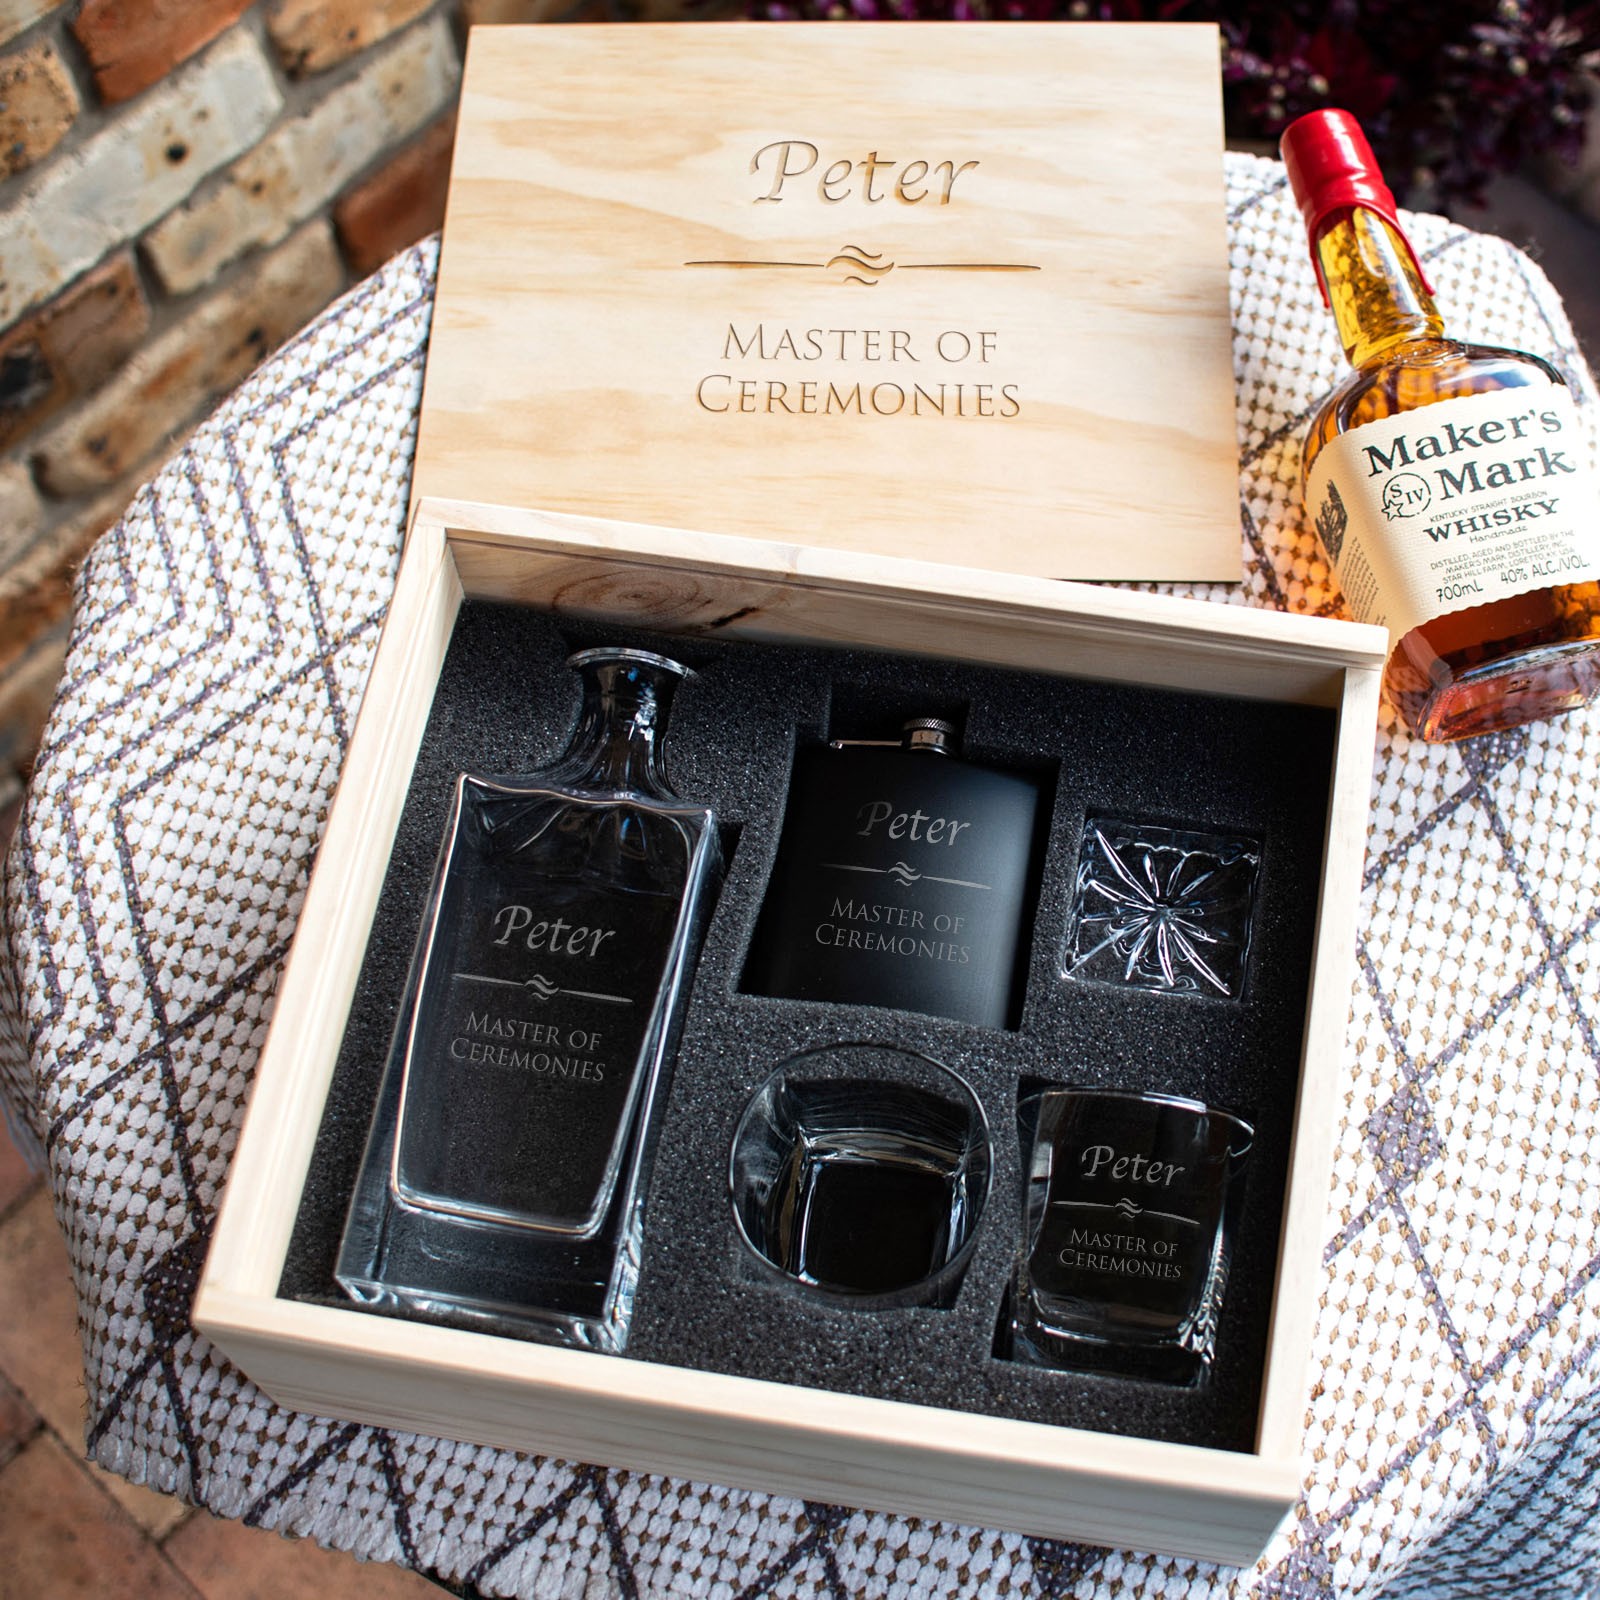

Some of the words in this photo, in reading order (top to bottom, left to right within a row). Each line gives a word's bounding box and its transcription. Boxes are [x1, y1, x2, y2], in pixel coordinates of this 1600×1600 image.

[749, 140, 980, 205] Peter
[720, 322, 920, 362] MASTER
[936, 330, 998, 363] OF
[695, 374, 1021, 418] CEREMONIES
[1362, 409, 1562, 477] Maker's
[1434, 447, 1576, 500] Mark
[1423, 498, 1560, 542] WHISKY
[1429, 508, 1469, 523] KENTUCKY
[1470, 498, 1507, 513] STRAIGHT
[1510, 490, 1548, 503] BOURBON
[1430, 555, 1470, 570] DISTILLED,
[1472, 549, 1493, 559] AGED
[1495, 543, 1511, 553] AND
[1513, 535, 1548, 547] BOTTLED
[1549, 532, 1559, 540] BY
[1561, 529, 1576, 537] THE
[1469, 525, 1528, 544] Handmade
[1442, 573, 1462, 584] STAR
[1464, 569, 1482, 579] HILL
[1445, 560, 1481, 574] MAKER'S
[1483, 554, 1506, 566] MARK
[1435, 579, 1484, 602] 700mL
[1500, 568, 1529, 584] 40%
[855, 801, 971, 846] Peter
[493, 905, 616, 957] Peter
[829, 896, 926, 930] MASTER
[933, 914, 965, 935] OF
[815, 923, 970, 964] CEREMONIES
[465, 1011, 560, 1046] MASTER
[568, 1030, 602, 1051] OF
[450, 1037, 606, 1082] CEREMONIES
[1081, 1145, 1186, 1186] Peter
[1059, 1248, 1182, 1278] CEREMONIES
[1070, 1228, 1147, 1253] MASTER
[1153, 1240, 1179, 1257] OF
